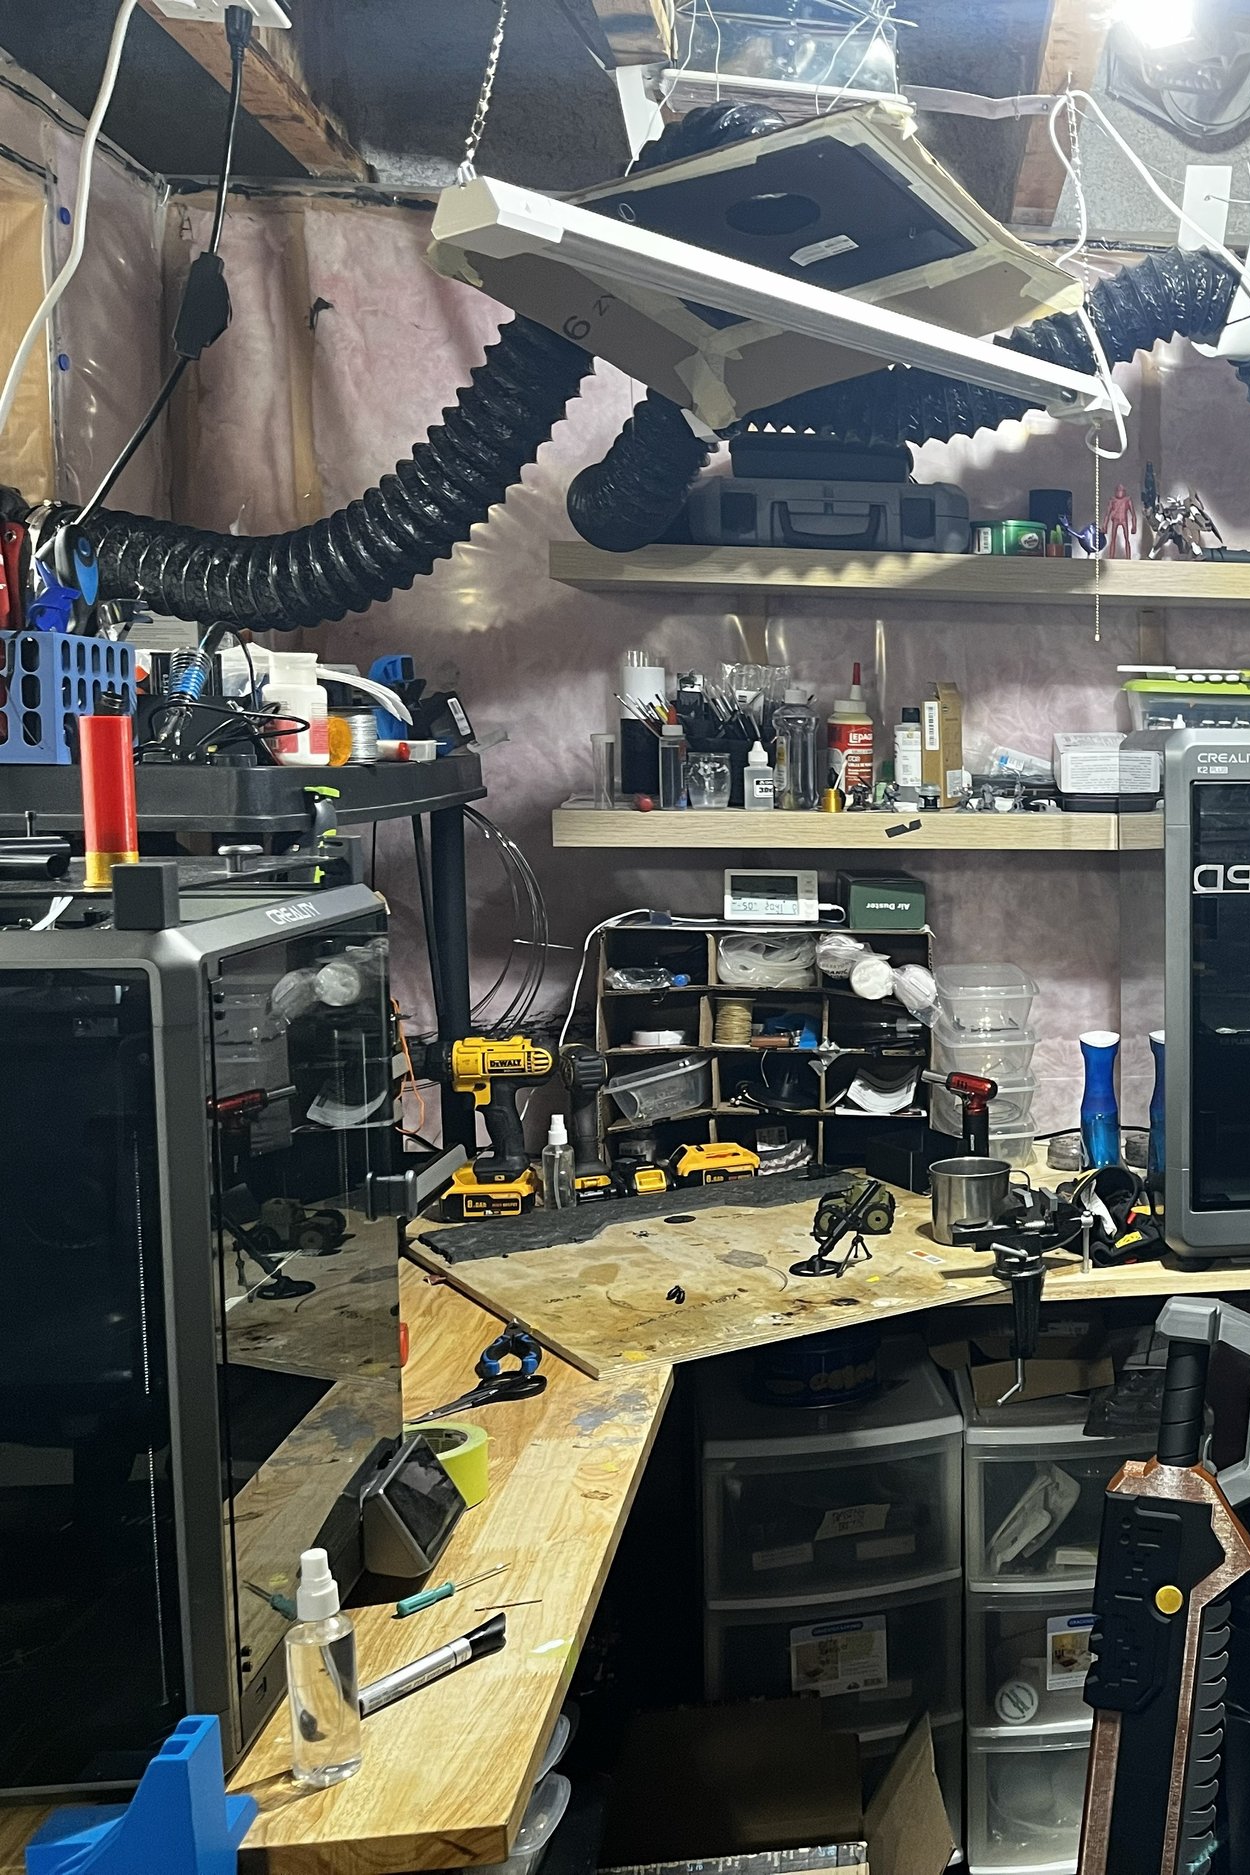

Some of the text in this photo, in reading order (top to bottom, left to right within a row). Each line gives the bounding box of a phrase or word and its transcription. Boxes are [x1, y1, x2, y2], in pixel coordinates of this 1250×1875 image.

[1197, 766, 1208, 774] K2
[866, 902, 910, 911] Air Duster
[265, 902, 320, 925] CREALITY
